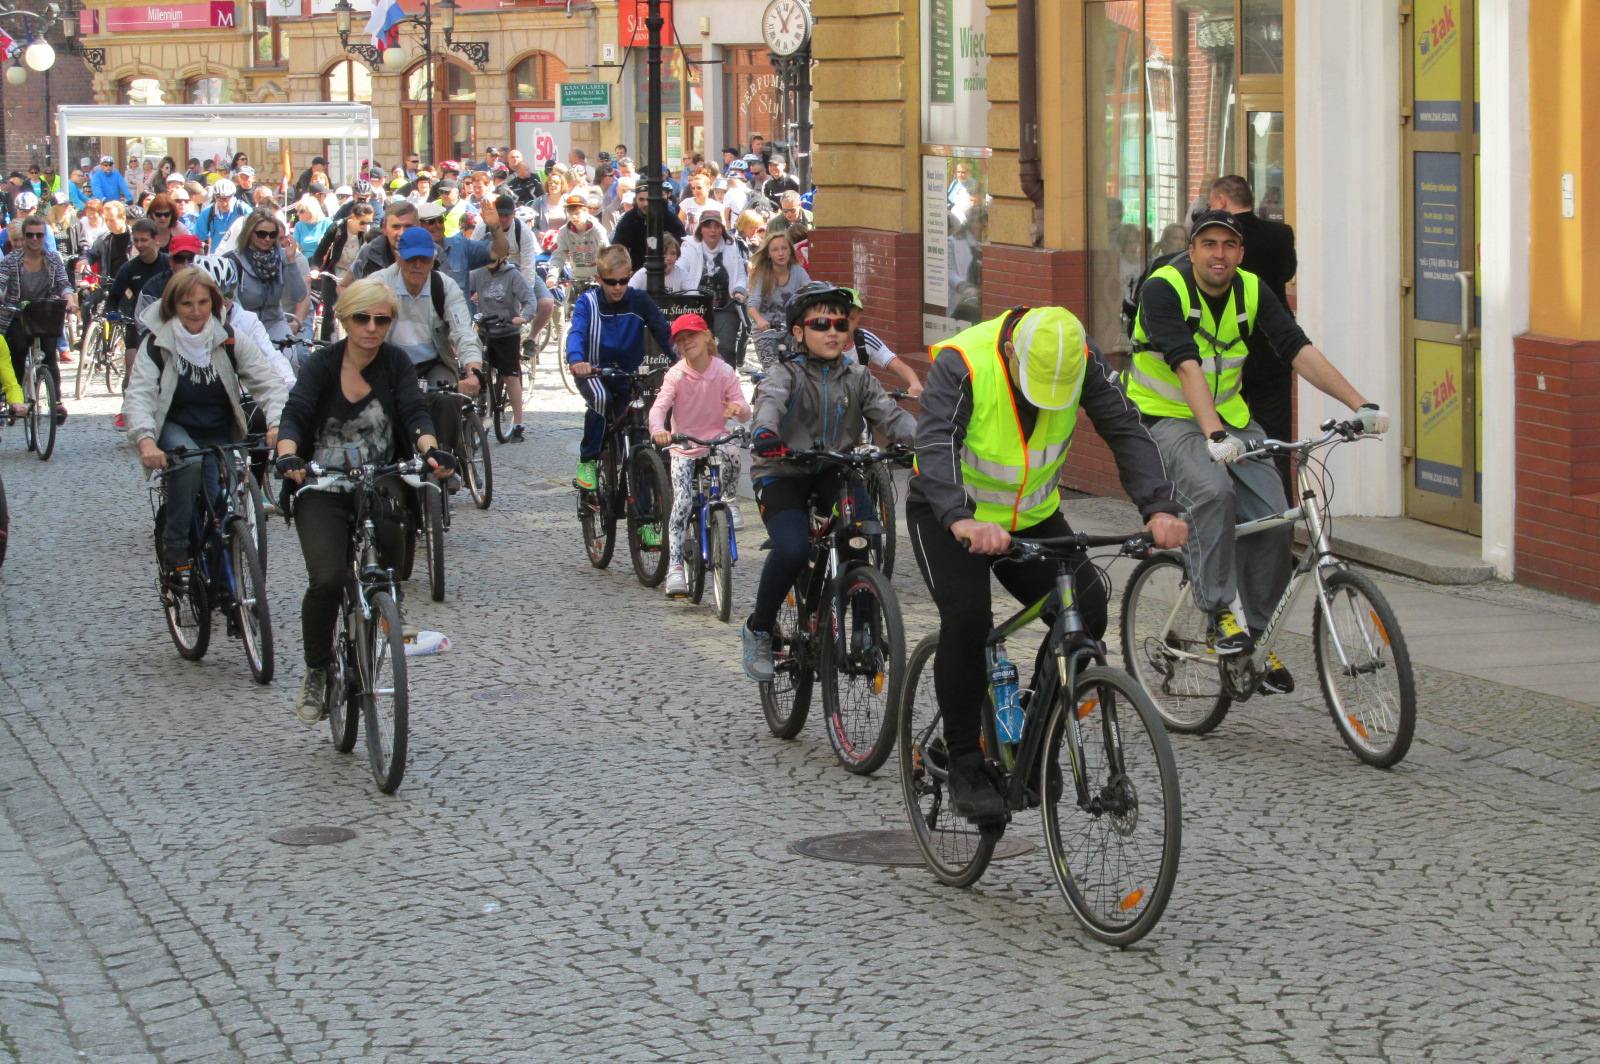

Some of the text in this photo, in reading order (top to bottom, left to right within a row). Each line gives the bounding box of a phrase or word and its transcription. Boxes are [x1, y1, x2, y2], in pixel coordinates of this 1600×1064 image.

[148, 8, 183, 21] Millennium
[960, 24, 989, 66] Więc
[536, 136, 553, 161] 50
[670, 303, 705, 316] Ślubnych
[642, 352, 671, 367] Atelie
